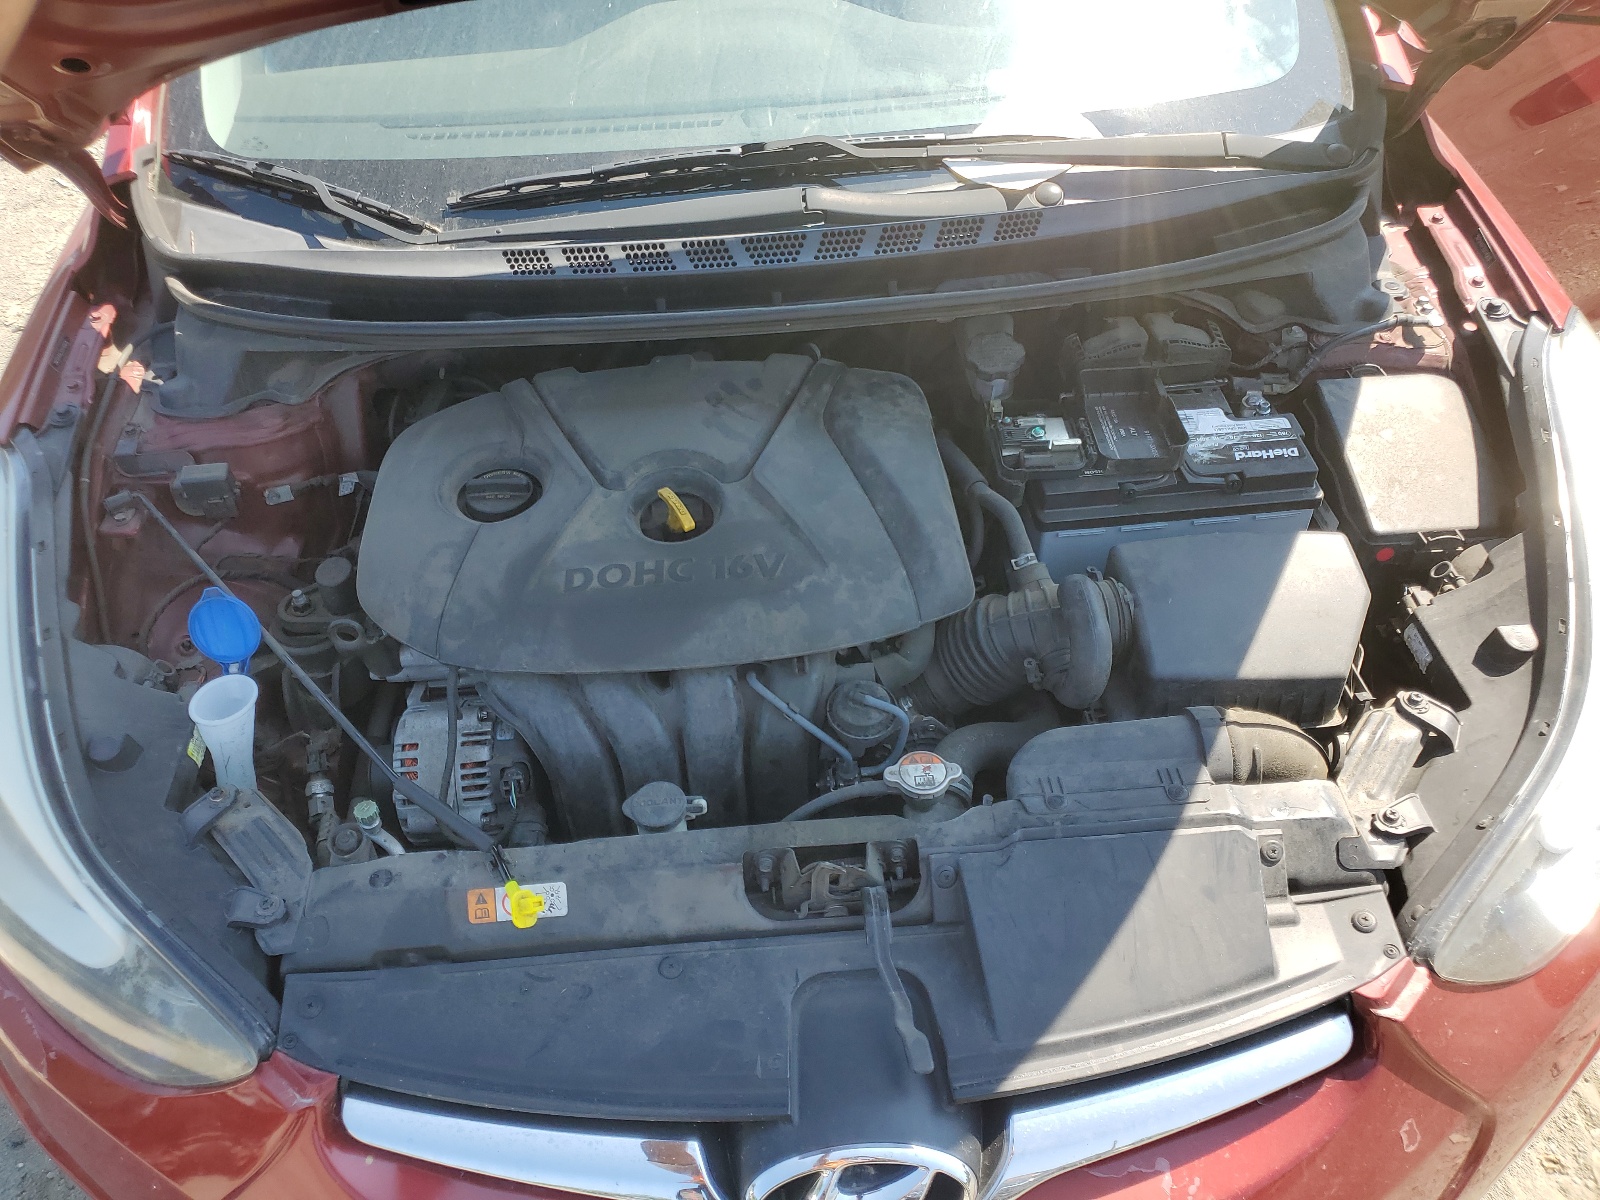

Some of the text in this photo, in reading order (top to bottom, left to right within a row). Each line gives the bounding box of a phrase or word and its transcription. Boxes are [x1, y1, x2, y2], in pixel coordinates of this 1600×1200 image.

[1234, 446, 1300, 461] DieHard
[565, 553, 786, 593] DOHC 16V
[632, 796, 685, 808] COOLANT
